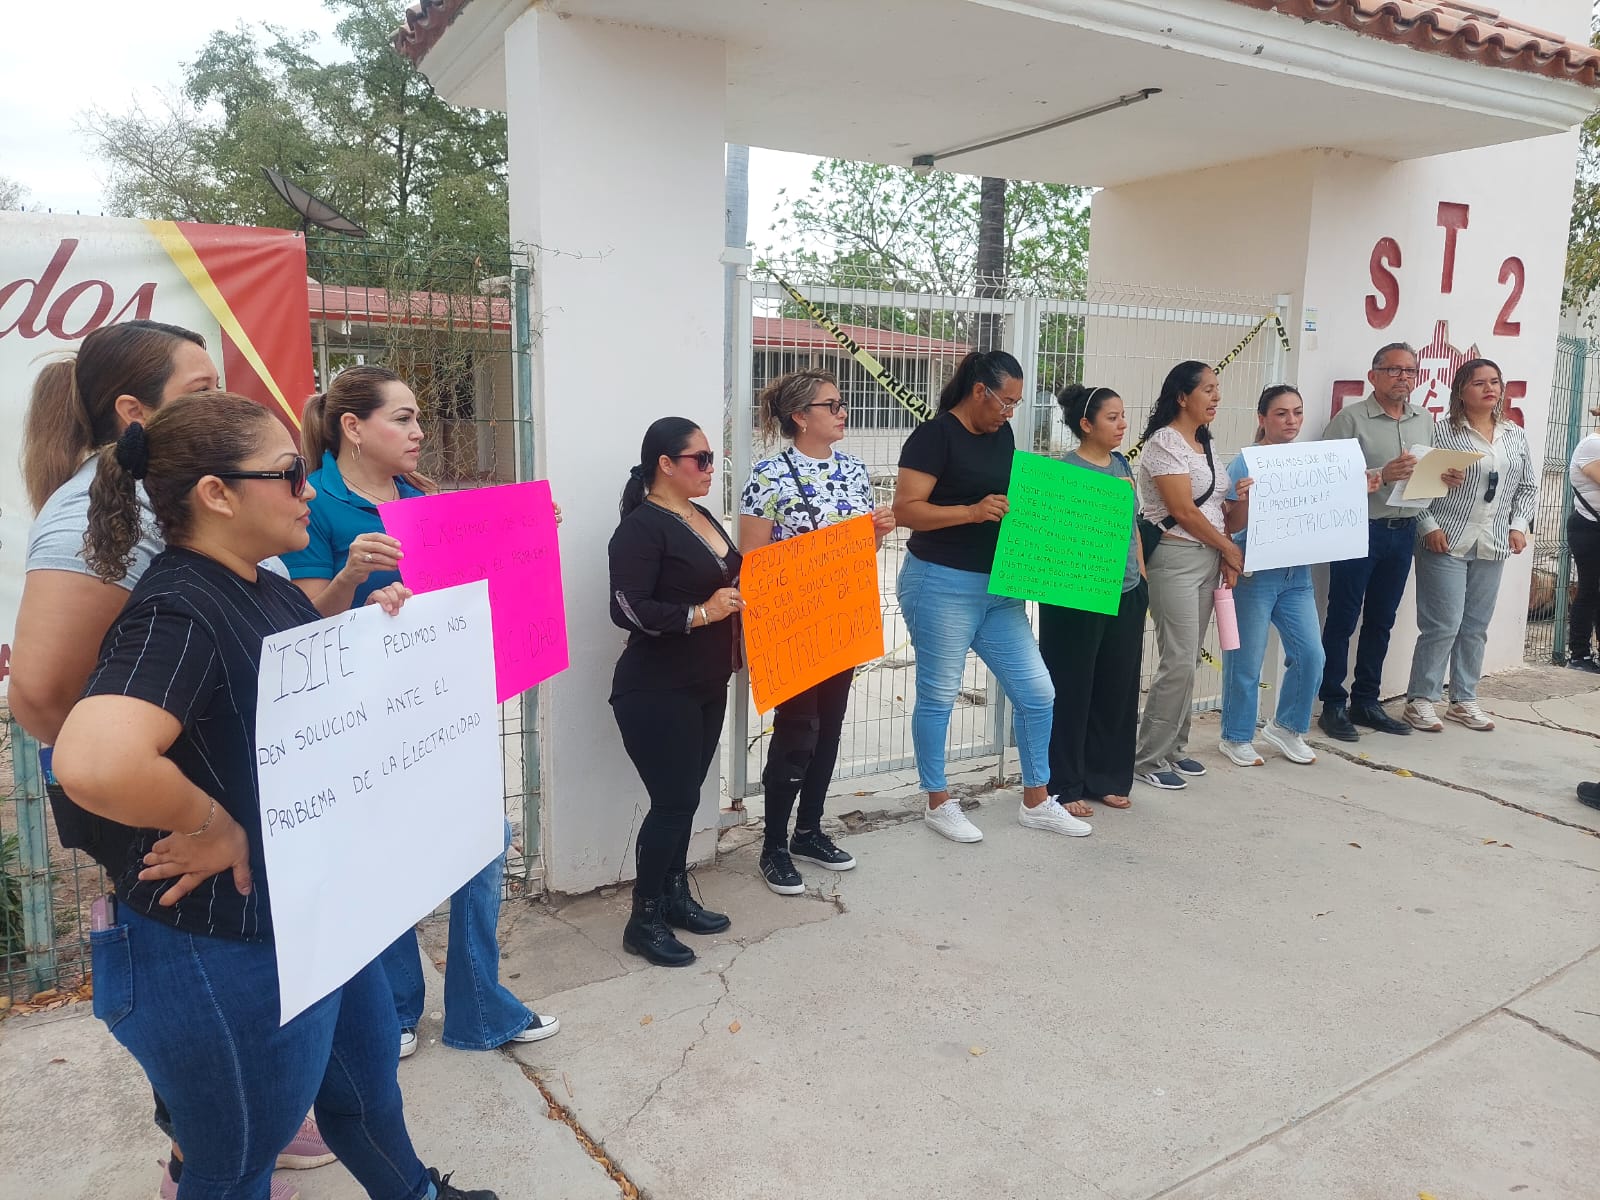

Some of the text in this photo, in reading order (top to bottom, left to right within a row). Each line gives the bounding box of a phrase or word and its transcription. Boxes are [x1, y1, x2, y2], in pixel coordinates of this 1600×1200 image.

[1256, 456, 1303, 469] EXIGIMOS
[383, 625, 437, 658] PEDIMOS
[447, 616, 467, 633] NOS
[258, 677, 449, 766] DEN SOLUCION ANTE EL
[266, 711, 481, 837] PROBLEMA DE LA ELECTRICIDAD
